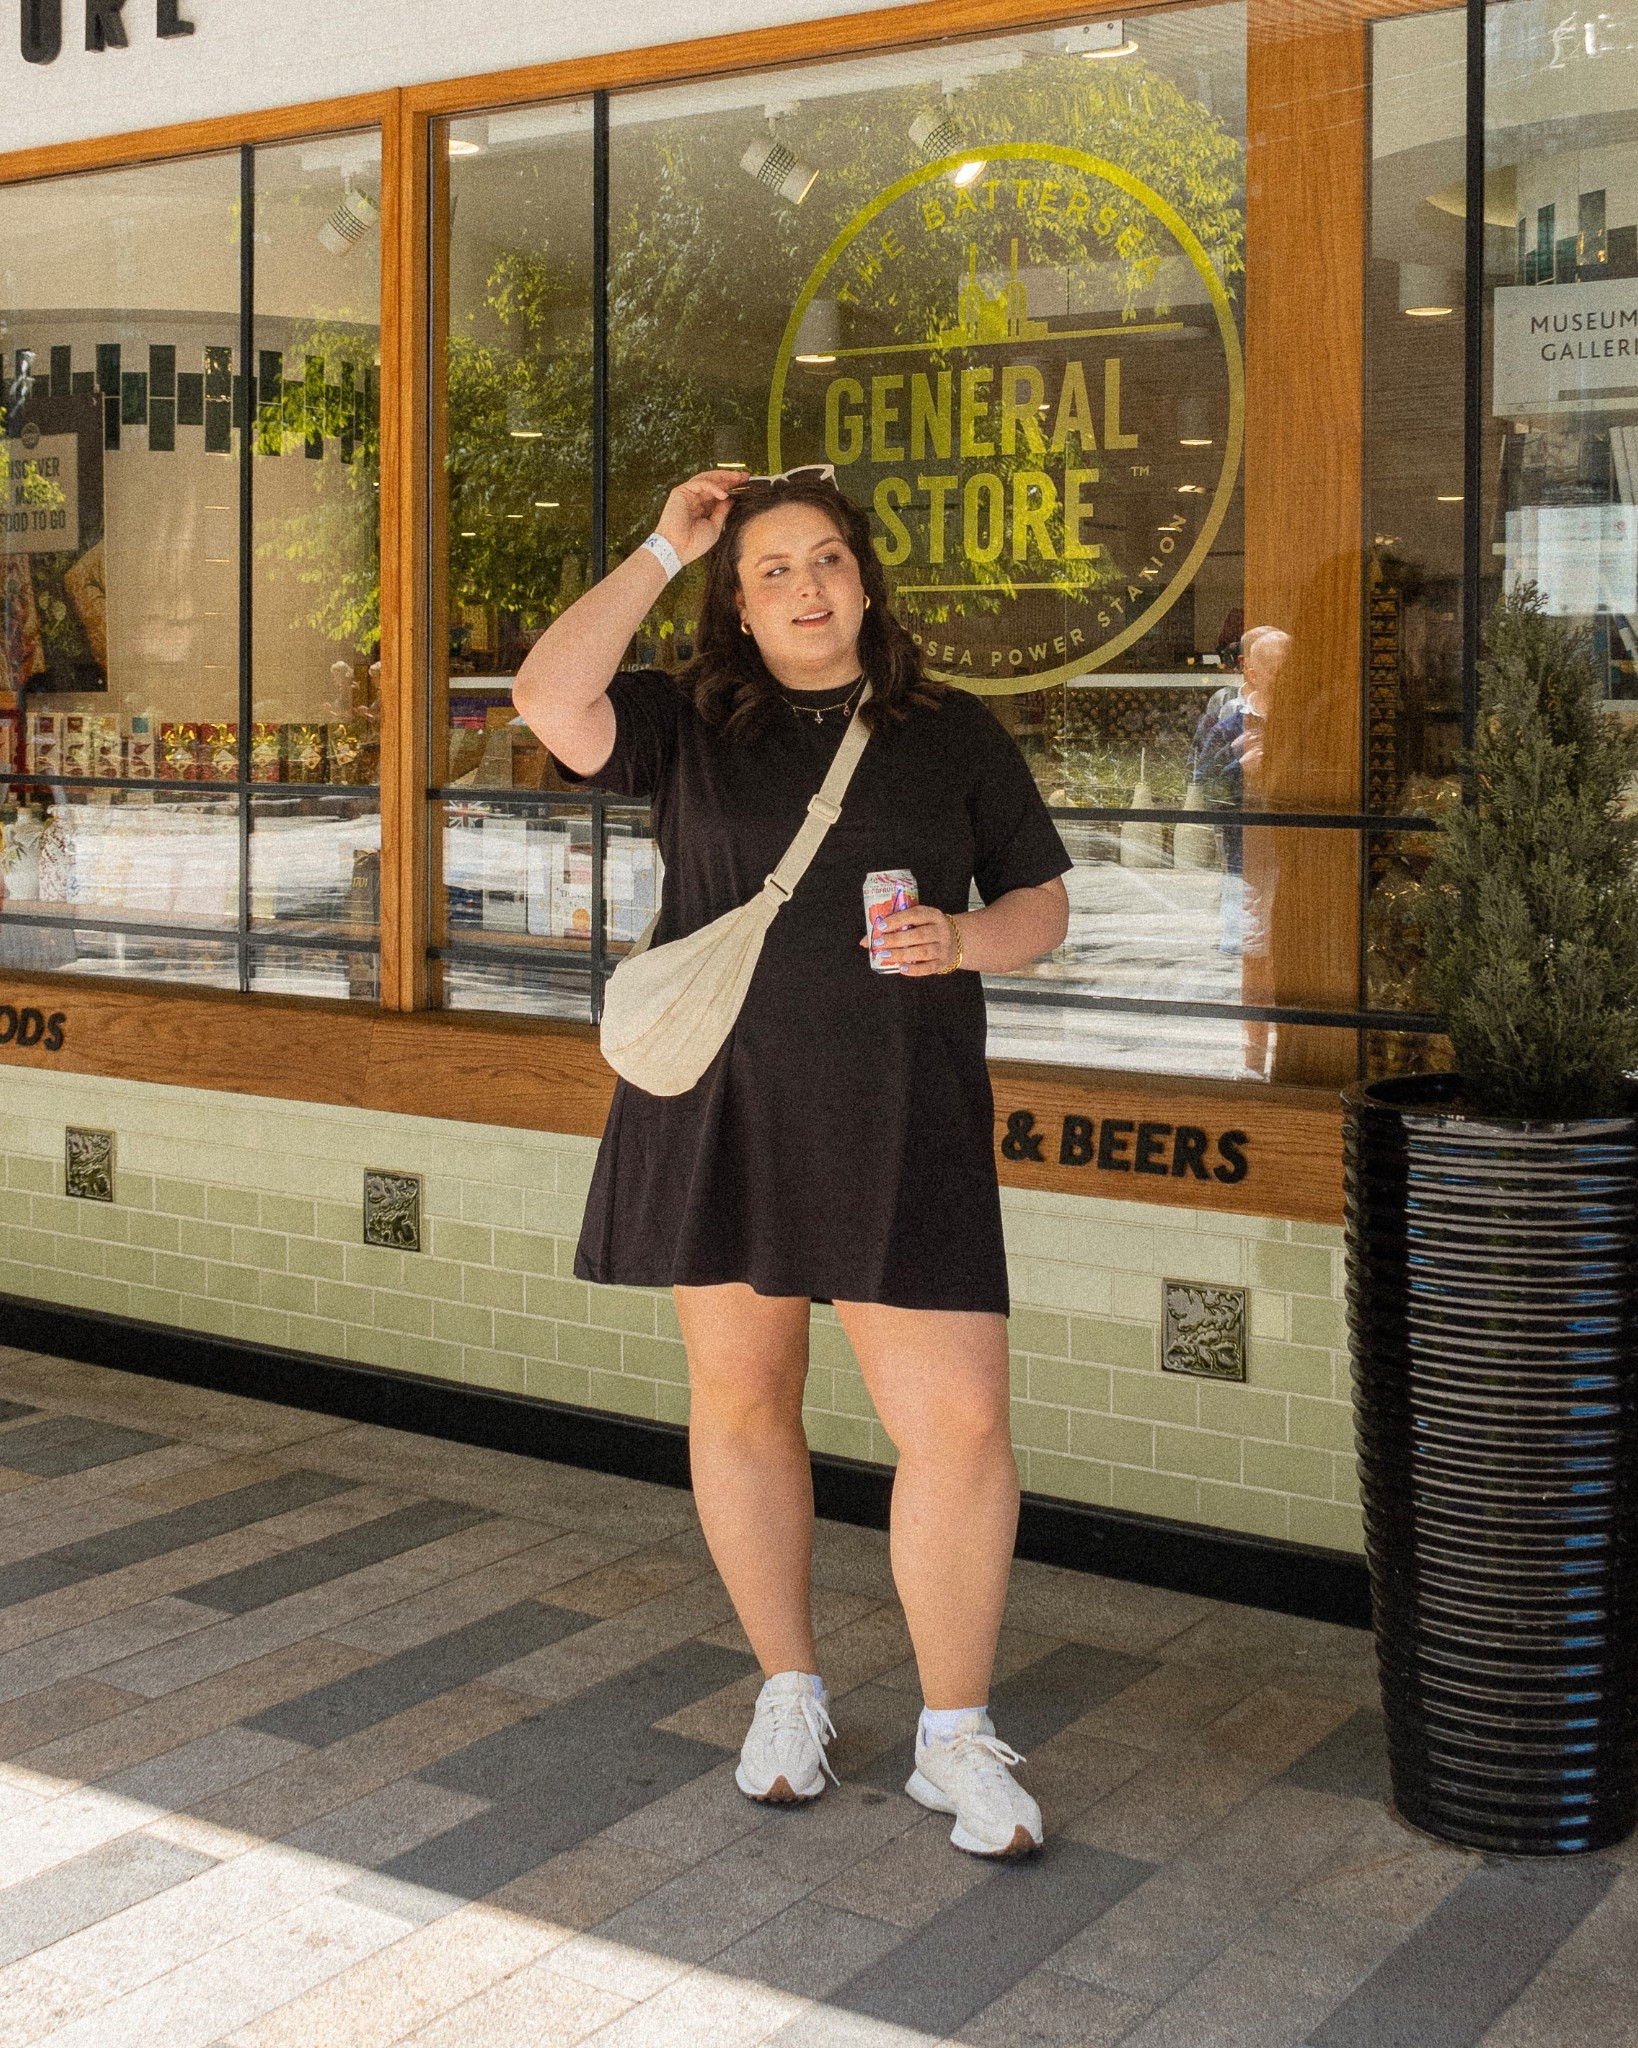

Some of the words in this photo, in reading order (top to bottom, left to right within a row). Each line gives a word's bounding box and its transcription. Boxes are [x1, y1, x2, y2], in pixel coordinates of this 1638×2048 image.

[837, 227, 905, 305] THE
[922, 179, 1161, 285] BATTERSEA
[1530, 309, 1638, 335] MUSEUM
[824, 357, 1138, 466] GENERAL
[8, 456, 60, 480] ISCVER
[31, 510, 47, 531] TO
[50, 509, 66, 530] GO
[873, 467, 1103, 567] STORE
[991, 628, 1085, 667] POWER
[1097, 514, 1187, 628] STATION
[1001, 1109, 1045, 1163] &
[1058, 1114, 1250, 1185] BEERS
